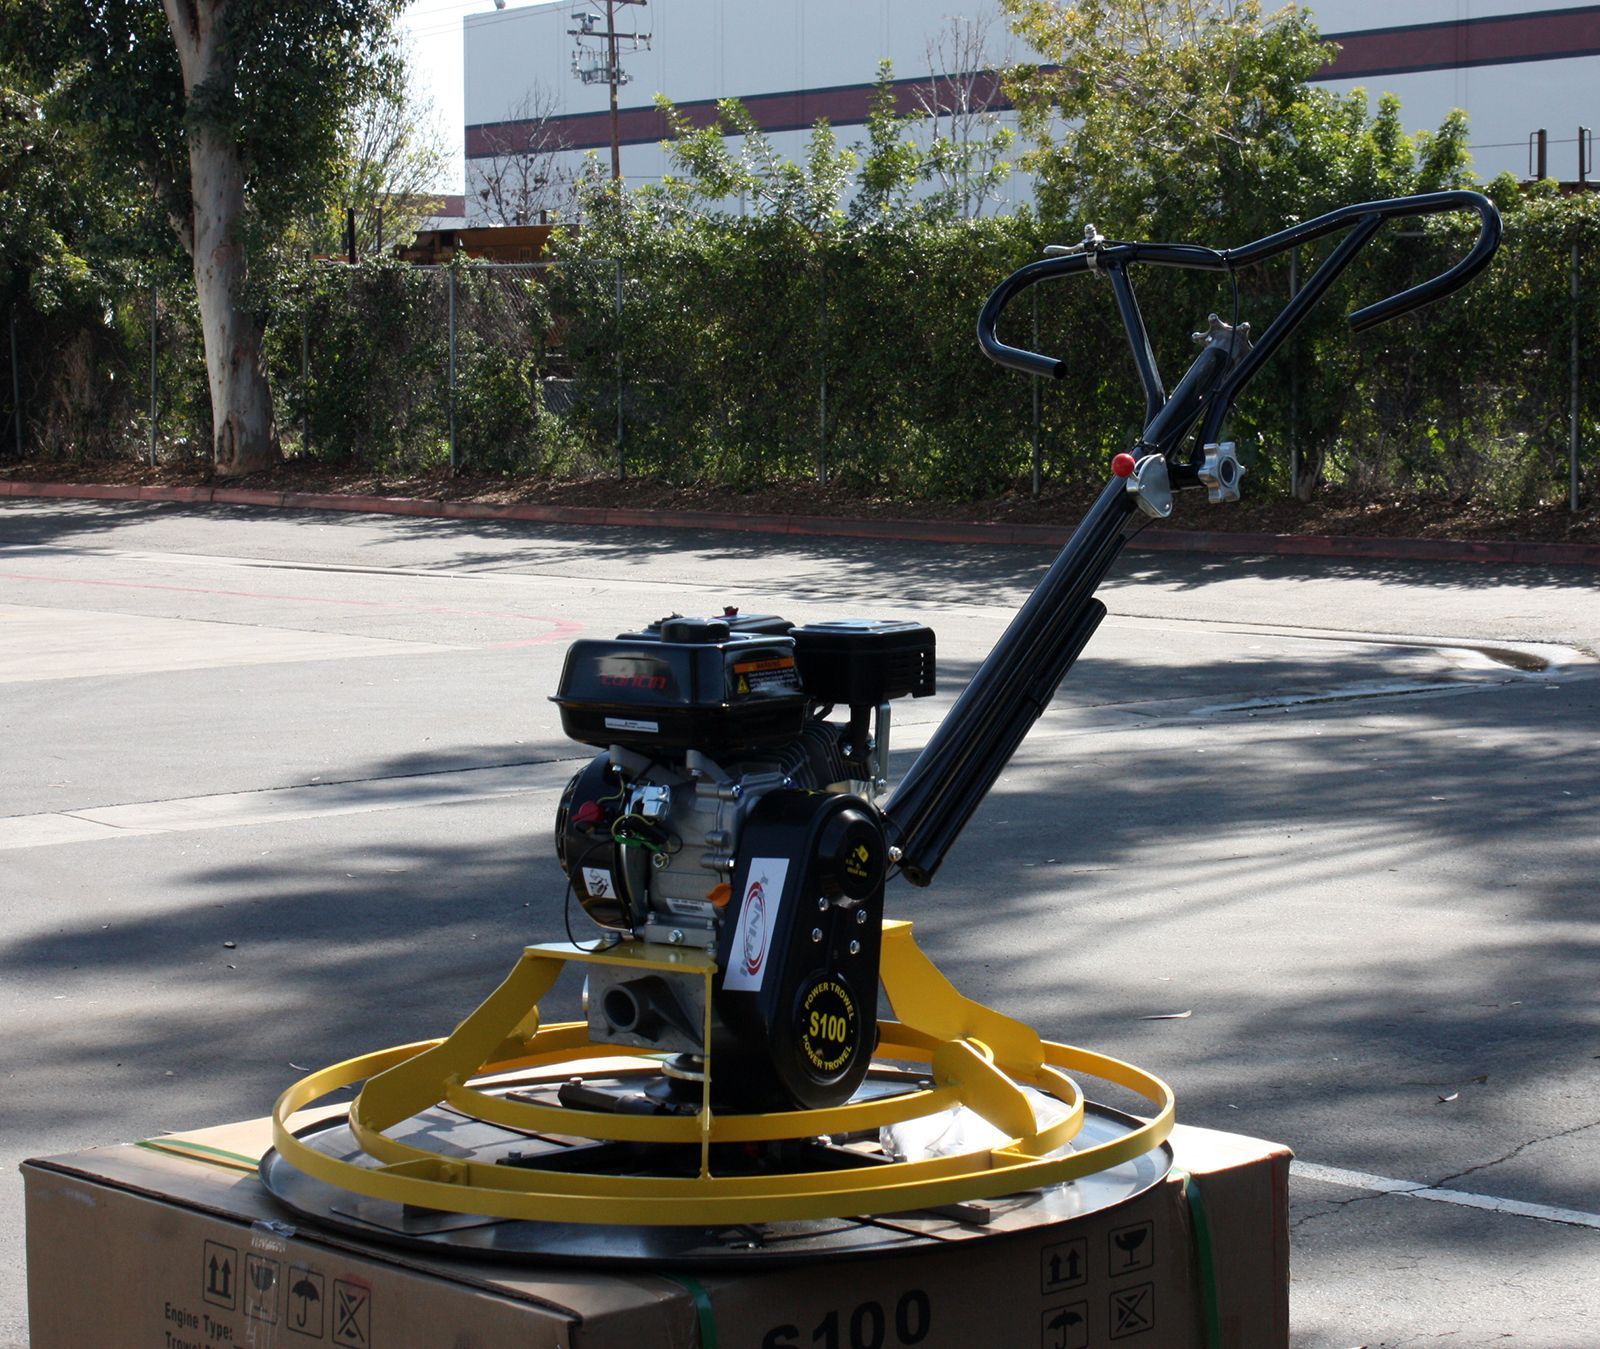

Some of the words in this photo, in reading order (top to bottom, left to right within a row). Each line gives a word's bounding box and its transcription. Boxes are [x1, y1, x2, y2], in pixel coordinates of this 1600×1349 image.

[804, 982, 829, 1010] POWER
[830, 982, 855, 1021] TROWEL
[809, 1010, 846, 1043] S100
[802, 1034, 823, 1068] POWER
[824, 1045, 852, 1071] TROWEL
[164, 1301, 199, 1329] Engine
[203, 1314, 233, 1341] Type:
